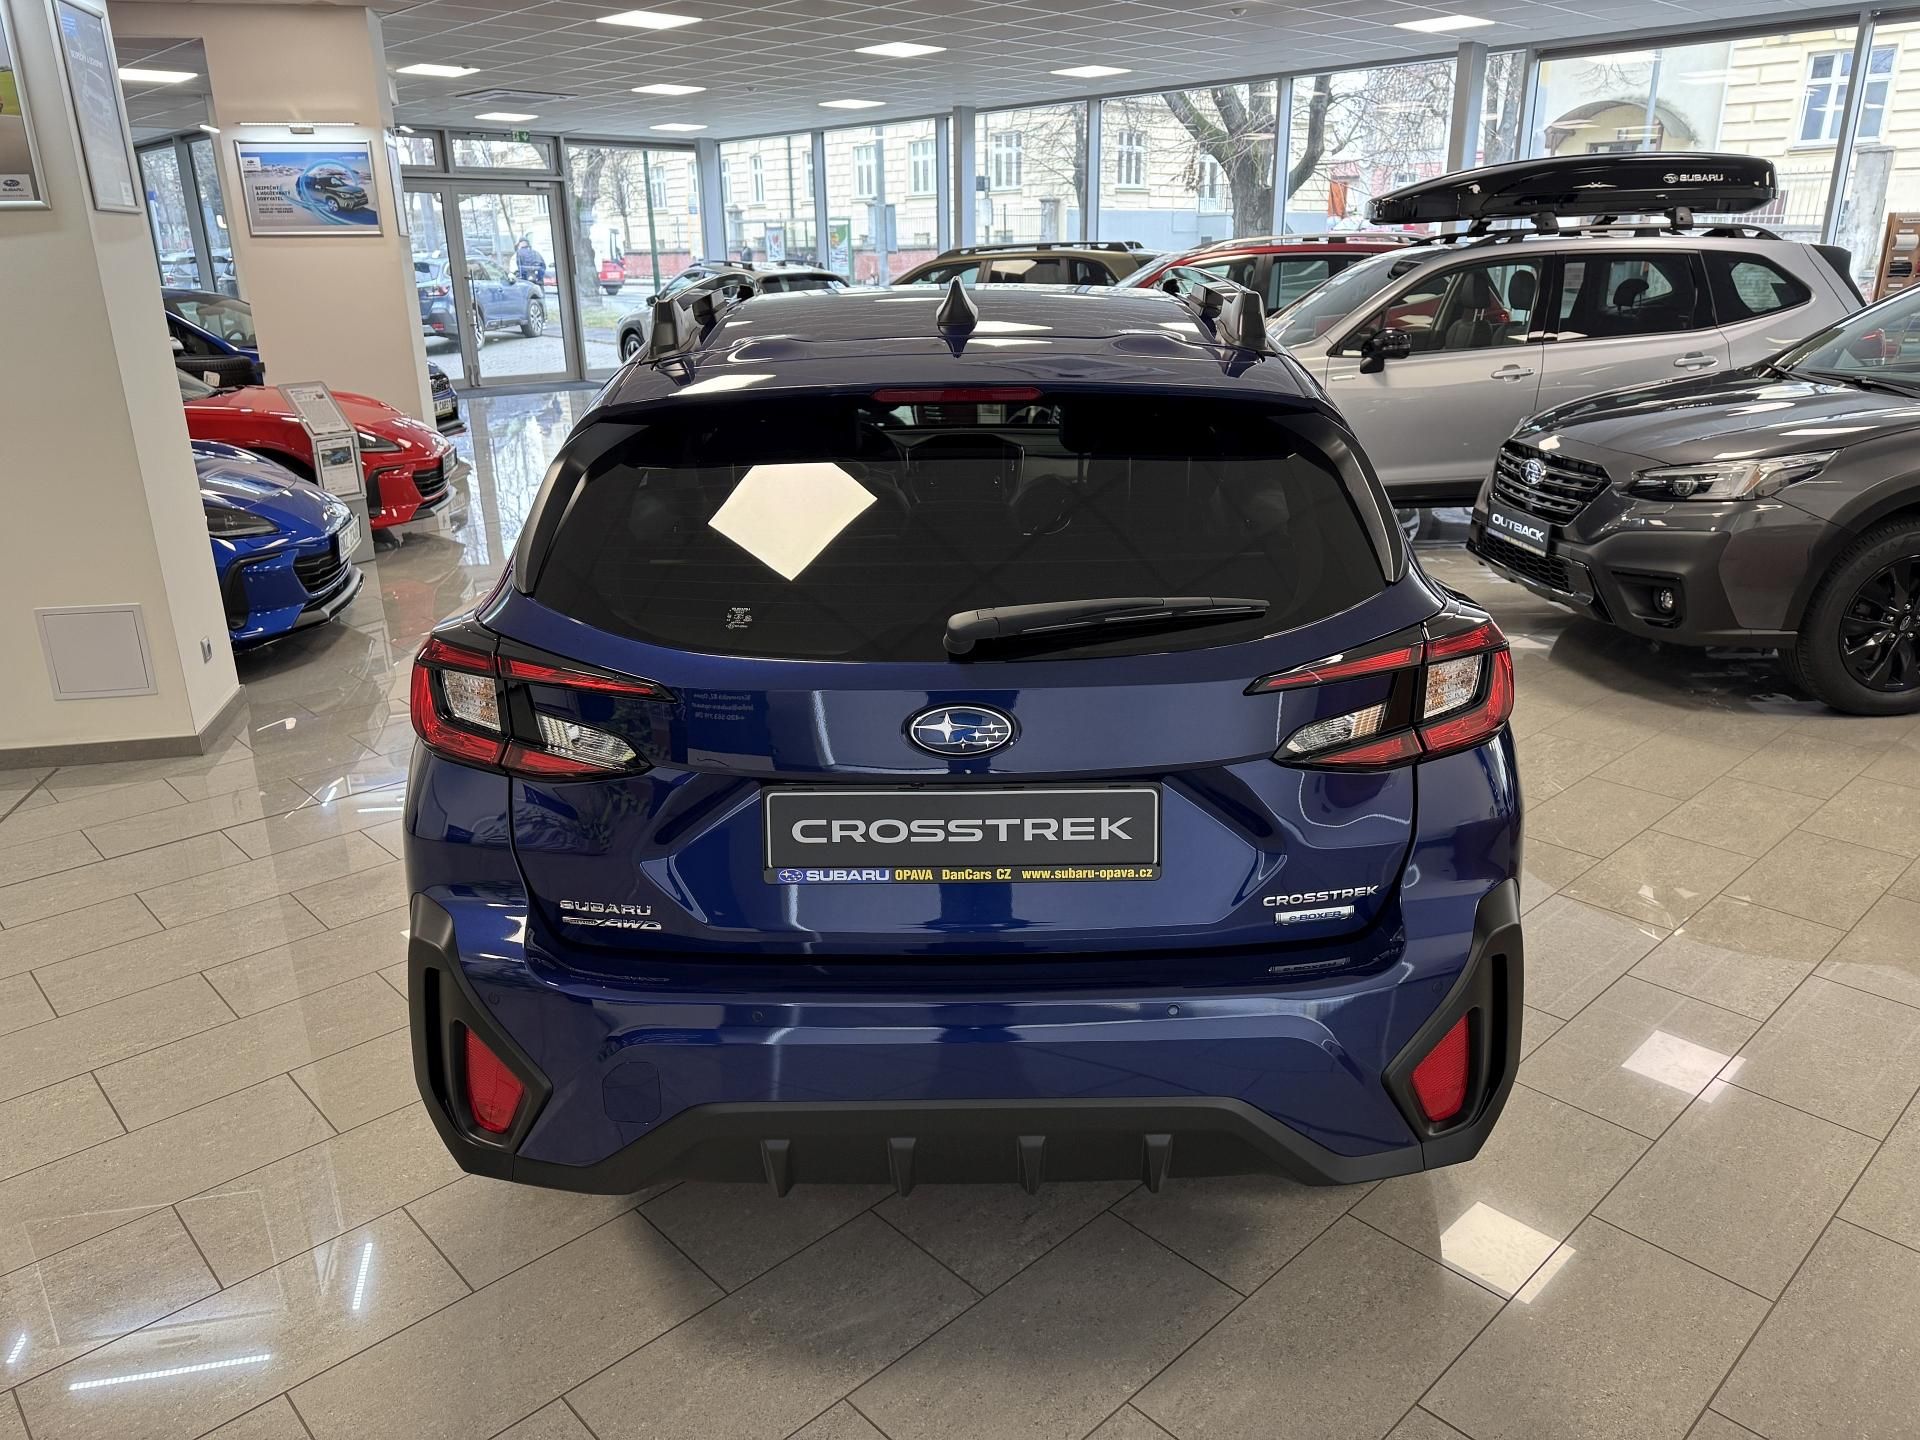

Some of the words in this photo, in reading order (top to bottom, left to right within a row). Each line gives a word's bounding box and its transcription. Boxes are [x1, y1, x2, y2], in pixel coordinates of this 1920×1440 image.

[1680, 173, 1724, 182] SUBARU
[1492, 513, 1545, 543] OUTBACK
[791, 816, 1134, 844] CROSSTREK
[806, 870, 890, 881] SUBARU
[895, 869, 933, 881] OPAVA
[942, 869, 992, 881] DanCars
[996, 869, 1012, 880] CZ
[1021, 868, 1153, 881] www.subaru-opava.cz
[1262, 885, 1379, 907] CROSSTREK
[560, 900, 652, 916] SUBARU
[1289, 910, 1342, 922] e-BOXER
[599, 918, 662, 931] AWD
